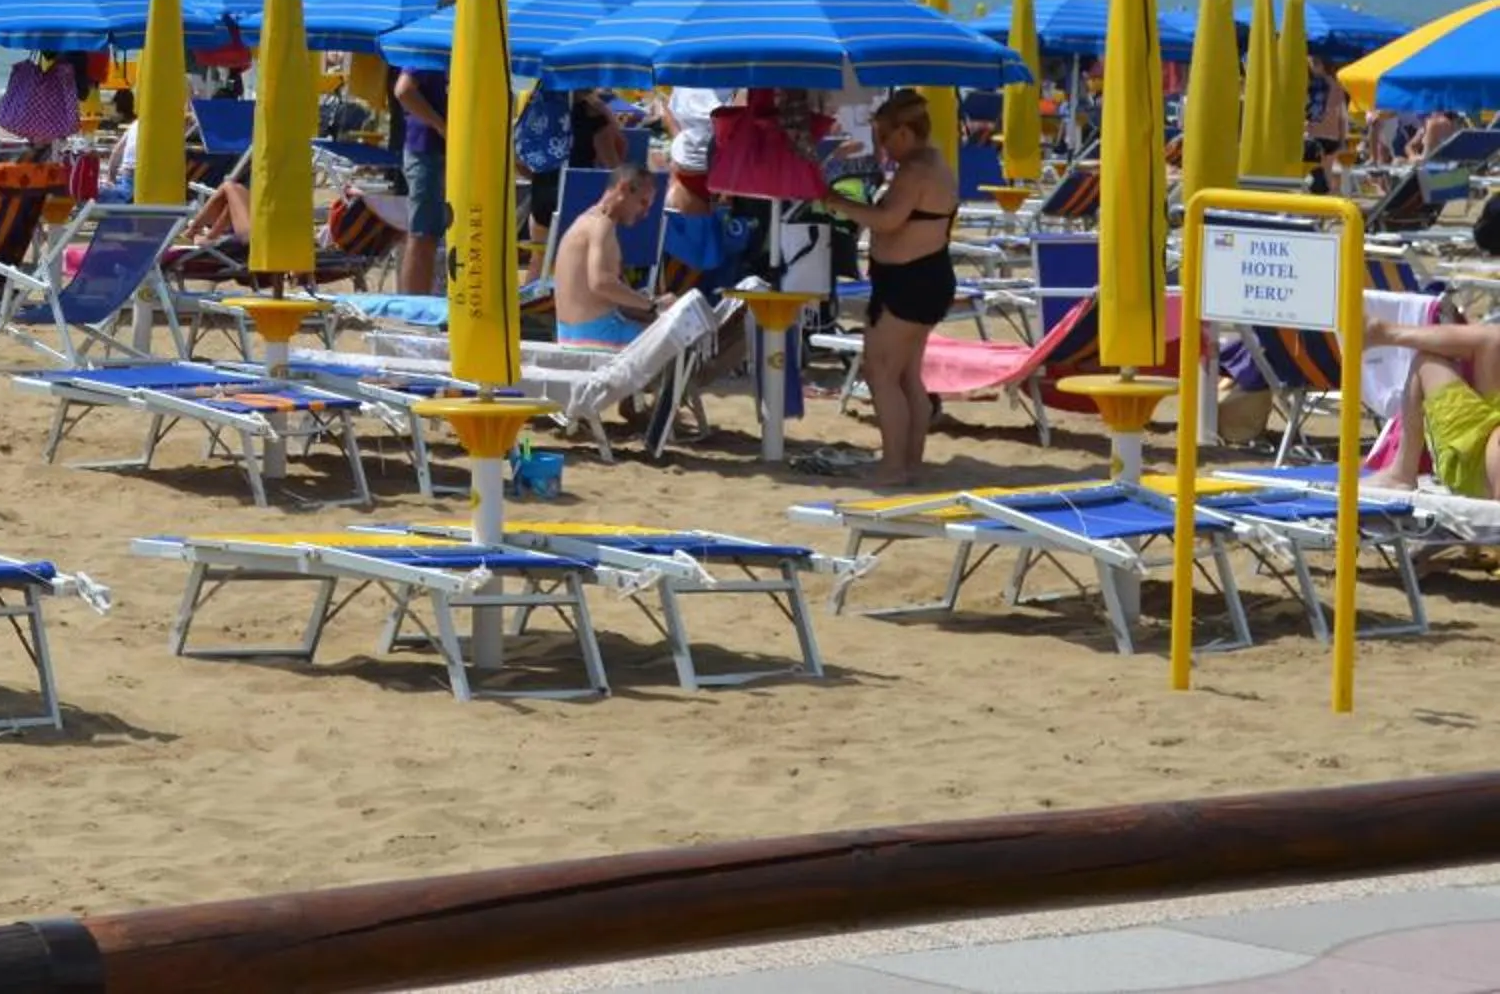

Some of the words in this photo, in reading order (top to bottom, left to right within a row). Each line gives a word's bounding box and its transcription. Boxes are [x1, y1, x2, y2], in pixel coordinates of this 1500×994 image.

[1250, 240, 1289, 257] PARK
[469, 204, 483, 319] SOLEMARE
[1241, 261, 1298, 279] HOTEL
